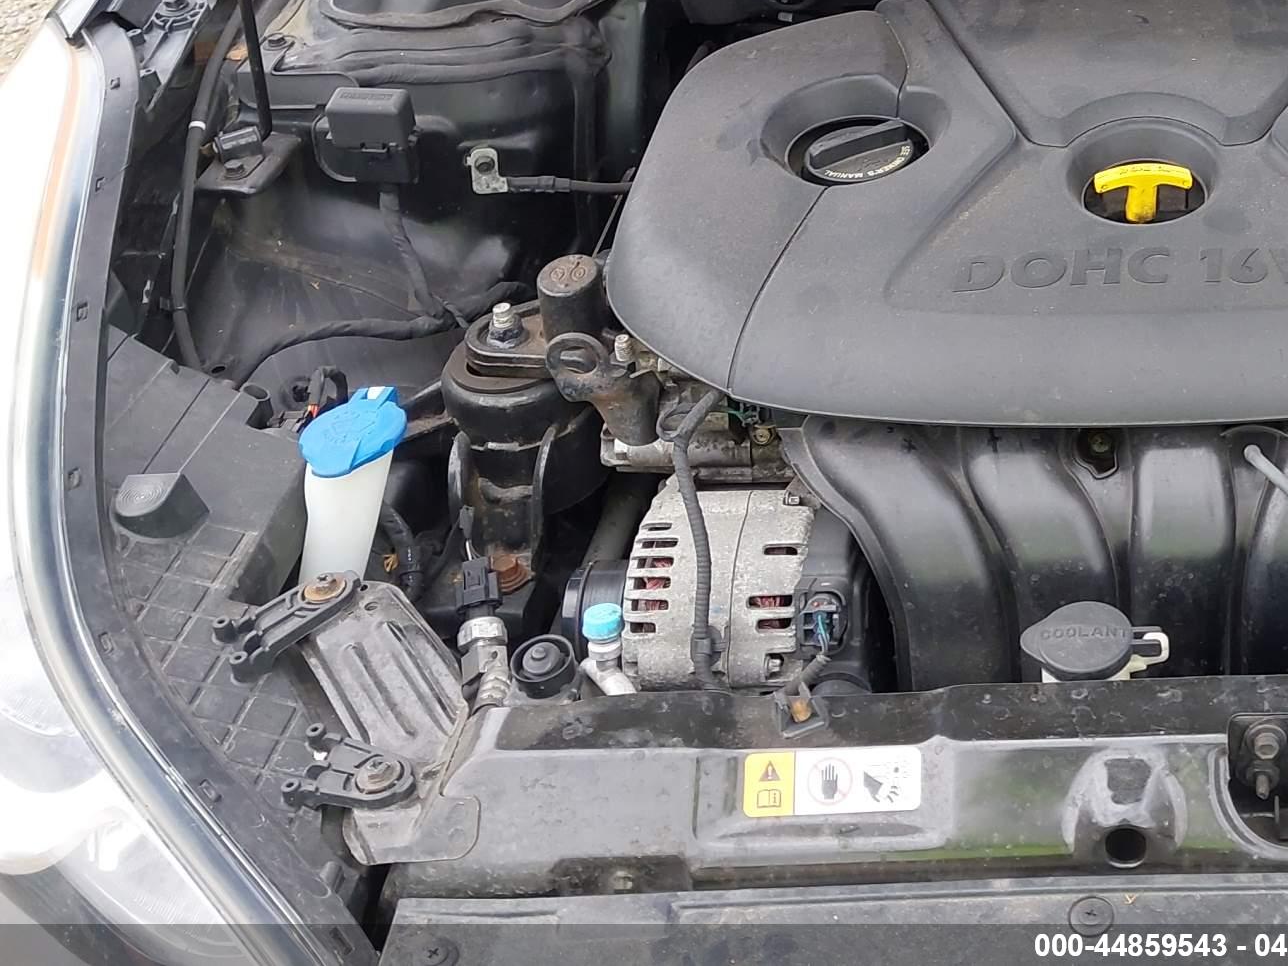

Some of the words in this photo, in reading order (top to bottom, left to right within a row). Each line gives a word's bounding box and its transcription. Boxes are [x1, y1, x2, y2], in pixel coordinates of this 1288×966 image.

[823, 169, 864, 179] MANUAL
[952, 247, 1170, 293] DOHC
[1039, 625, 1130, 641] COOLANT
